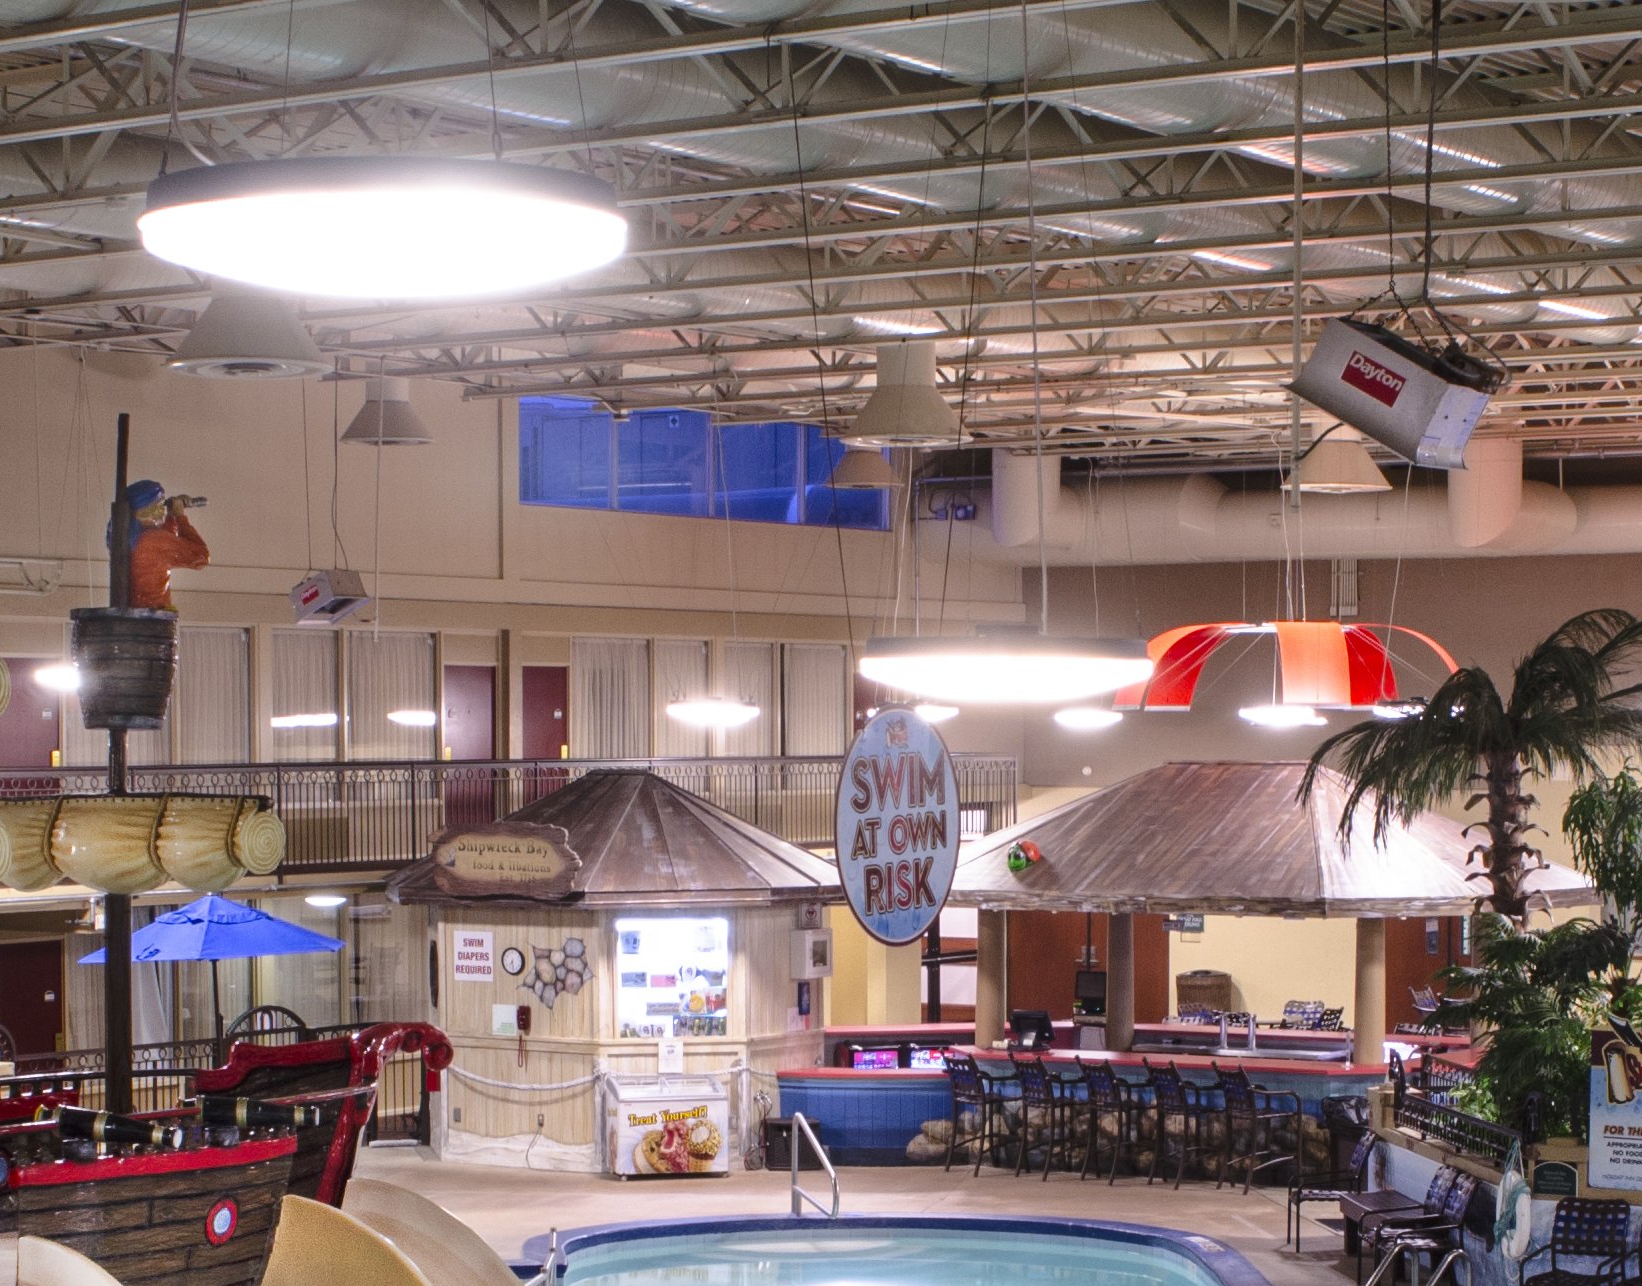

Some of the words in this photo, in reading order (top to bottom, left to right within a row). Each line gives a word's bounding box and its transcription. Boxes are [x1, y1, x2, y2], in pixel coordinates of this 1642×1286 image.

[1349, 353, 1403, 391] Dayton
[851, 751, 946, 814] SWIM
[851, 818, 881, 859] AT
[888, 810, 947, 854] OWN
[458, 838, 522, 855] Shipwreck
[526, 842, 548, 858] Bay
[864, 857, 936, 917] RISK
[463, 938, 484, 947] SWIM
[458, 952, 489, 961] DIAPERS
[455, 964, 492, 975] REQUIRED
[628, 1113, 657, 1127] Treat
[659, 1105, 708, 1122] Yourself!
[1603, 1125, 1624, 1135] FOR
